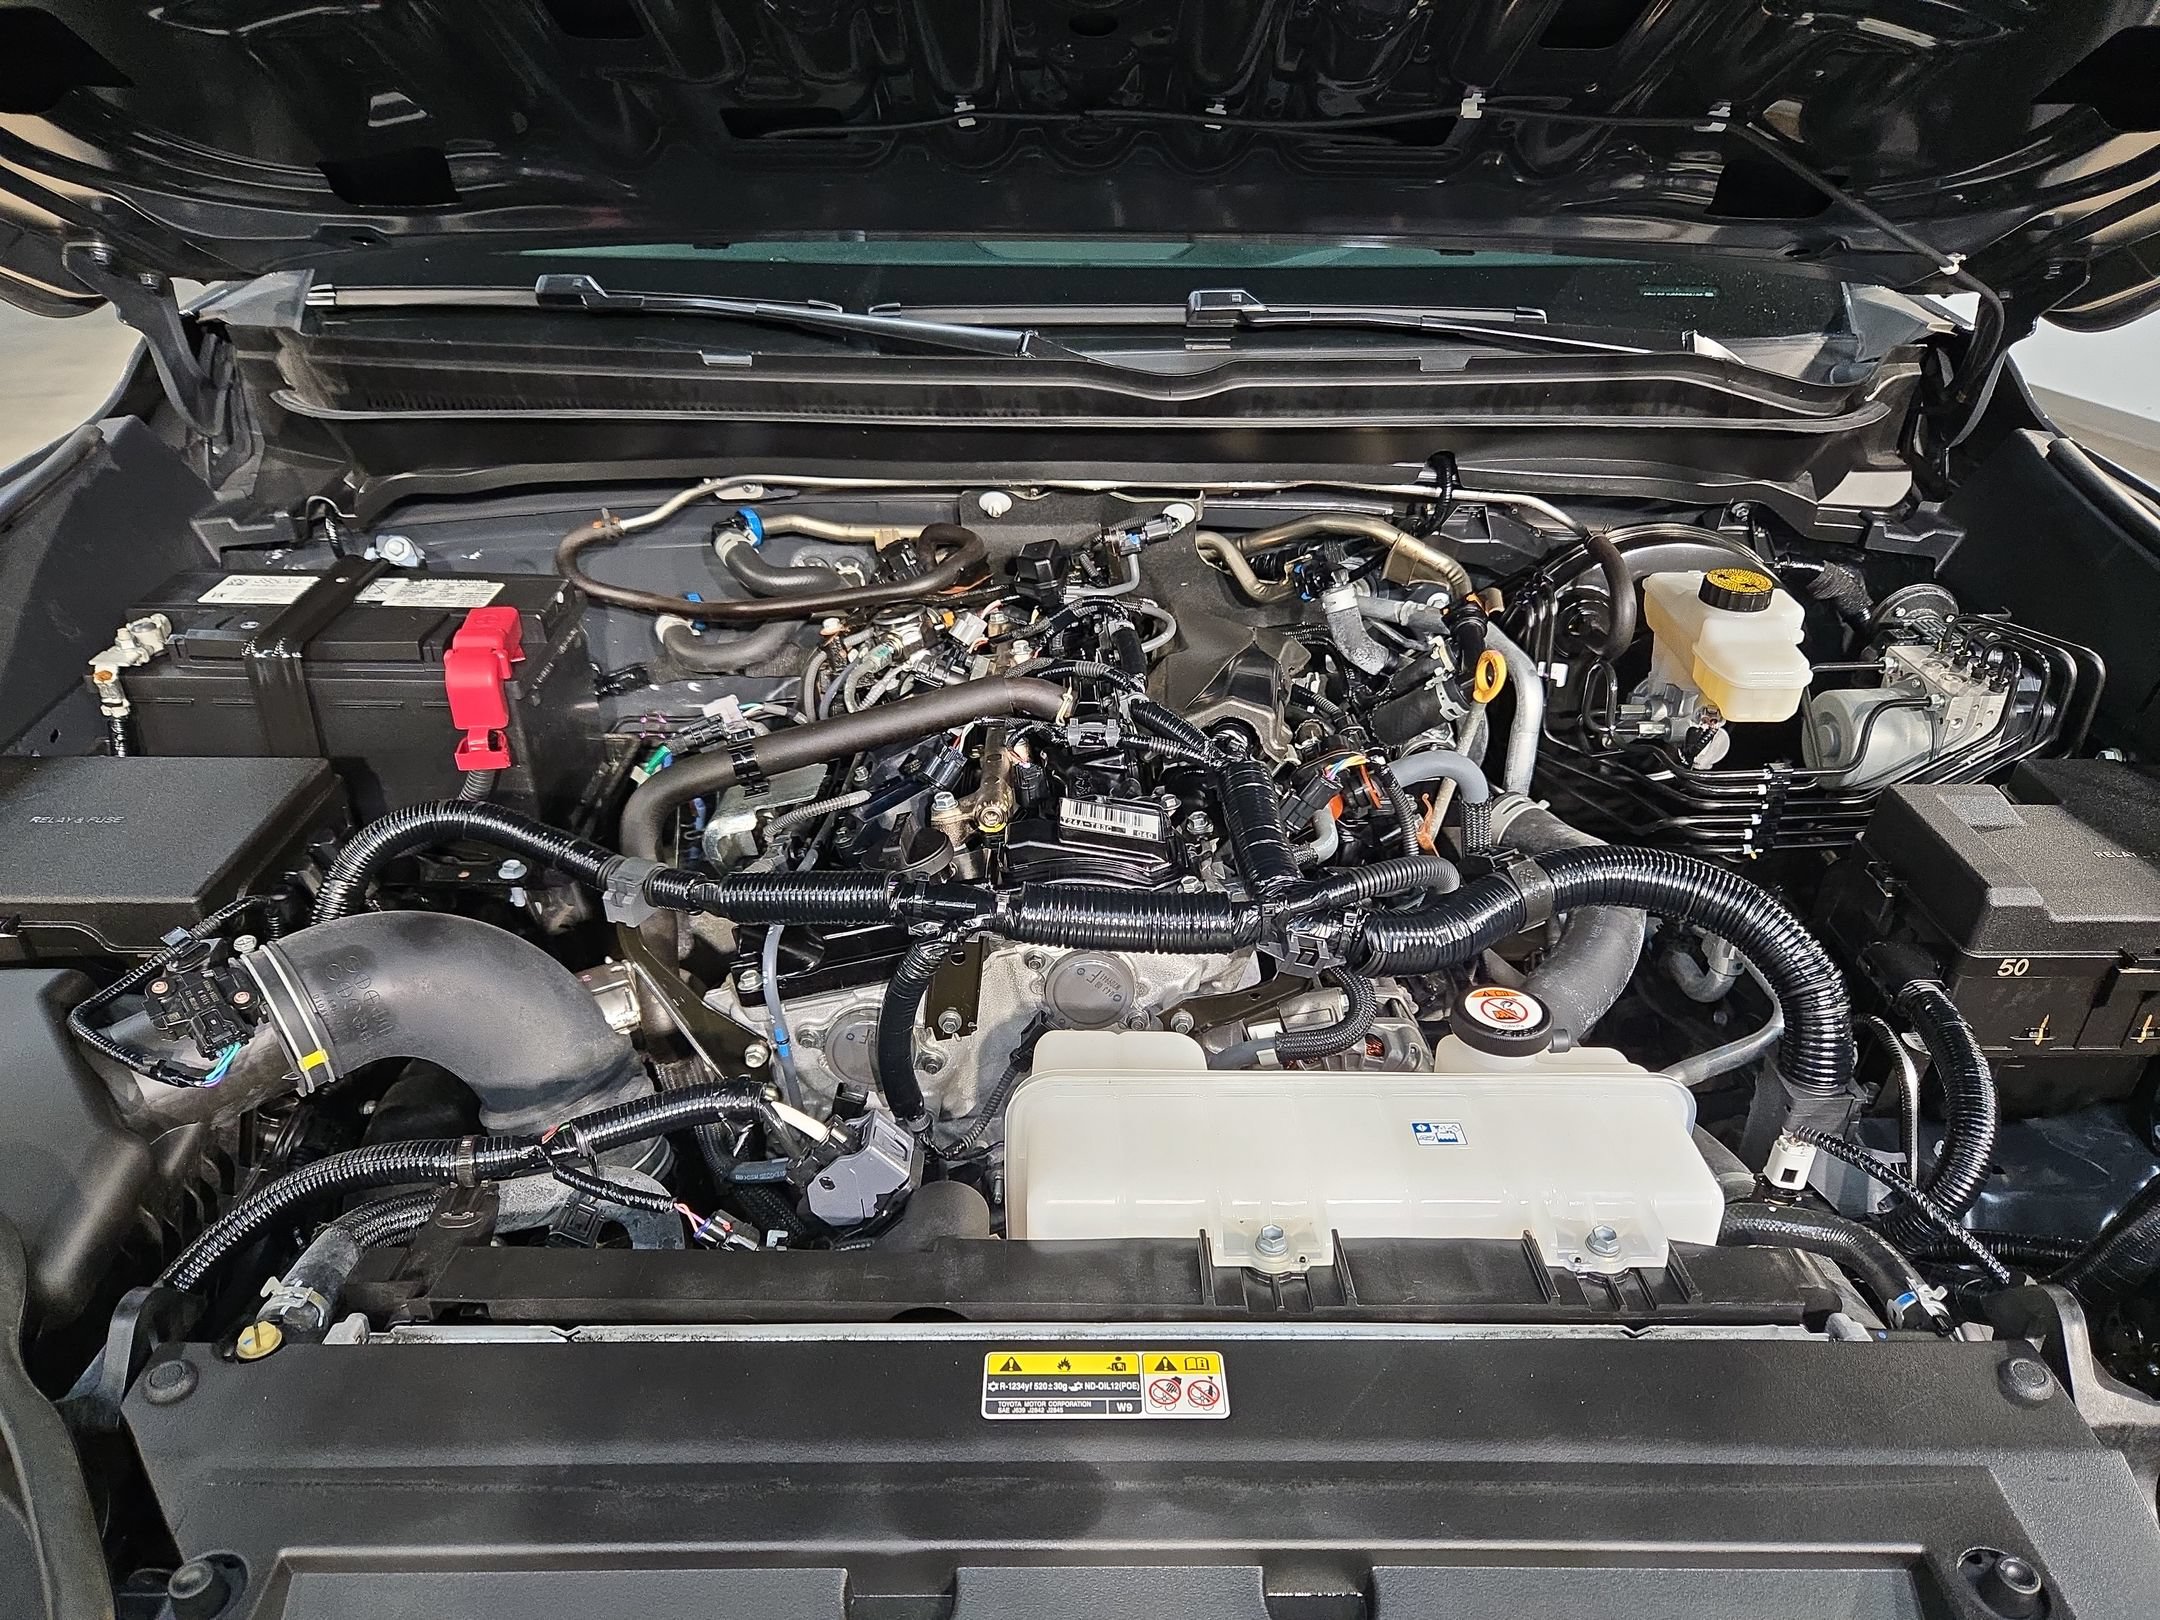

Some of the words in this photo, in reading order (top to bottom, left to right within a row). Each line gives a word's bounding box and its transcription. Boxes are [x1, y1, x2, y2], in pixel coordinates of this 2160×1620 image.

[29, 815, 73, 824] RELAY
[86, 815, 125, 824] FUSE
[1997, 958, 2030, 977] 50
[999, 1381, 1033, 1393] R-1234yf
[1033, 1381, 1068, 1393] 520±30g
[1084, 1381, 1140, 1392] ND-OIL12(POE)
[1116, 1401, 1134, 1412] W9
